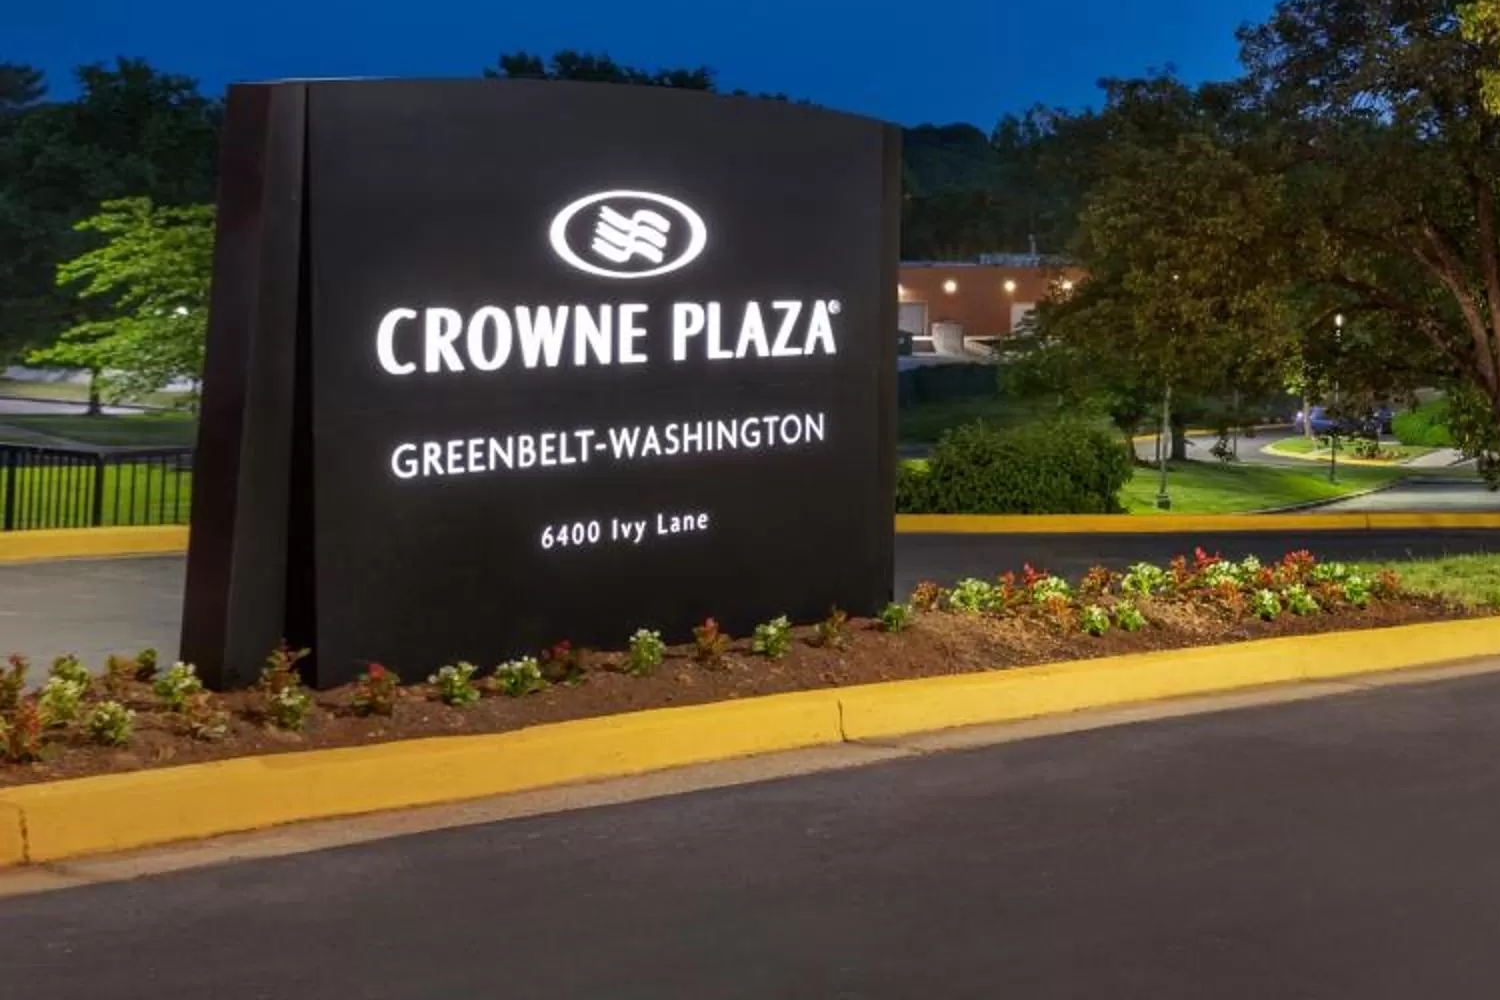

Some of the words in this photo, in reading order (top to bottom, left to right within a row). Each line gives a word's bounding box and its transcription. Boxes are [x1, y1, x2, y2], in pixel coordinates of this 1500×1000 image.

[376, 303, 648, 375] CROWNE
[390, 412, 825, 479] GREENBELT-WASHINGTON
[541, 520, 600, 549] 6400
[611, 519, 647, 544] Ivy
[657, 511, 709, 535] Lane
